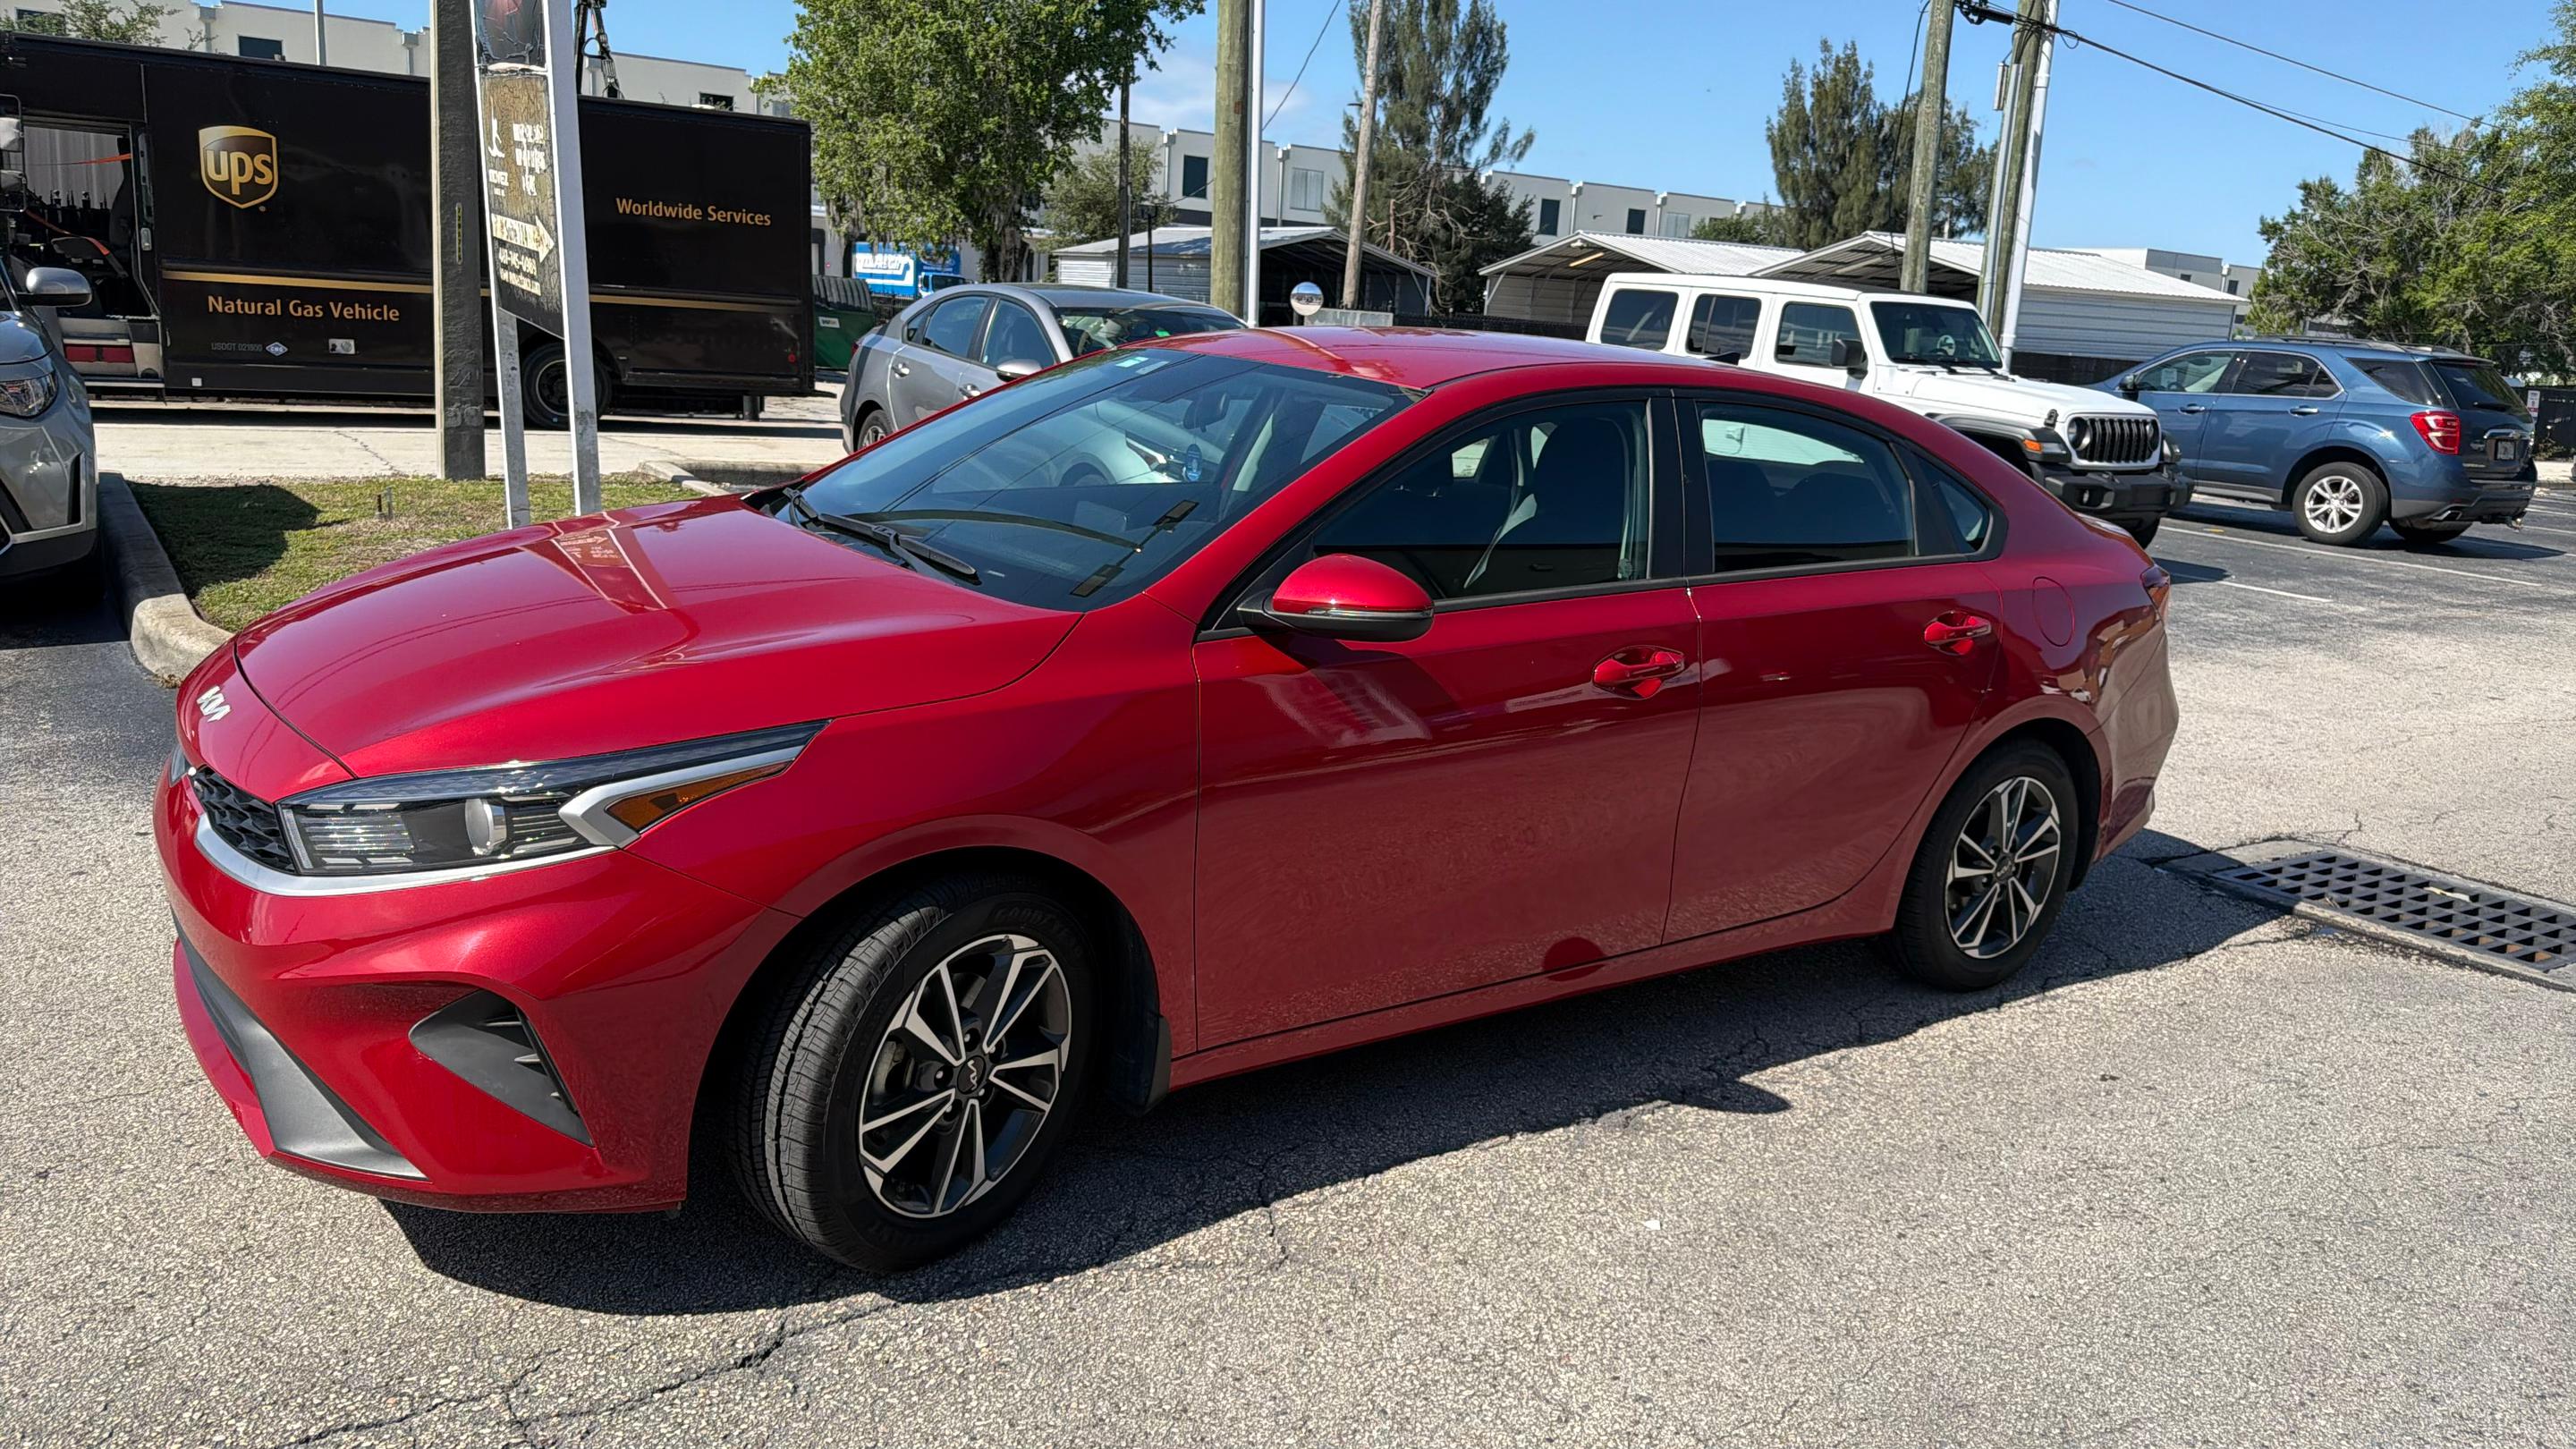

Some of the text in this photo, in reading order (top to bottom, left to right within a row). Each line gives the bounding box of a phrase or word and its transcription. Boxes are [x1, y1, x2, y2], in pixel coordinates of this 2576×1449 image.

[206, 150, 273, 195] ups
[616, 198, 771, 226] Worldwide Services
[208, 295, 400, 321] Natural Gas Vehicle
[197, 685, 231, 723] KIA
